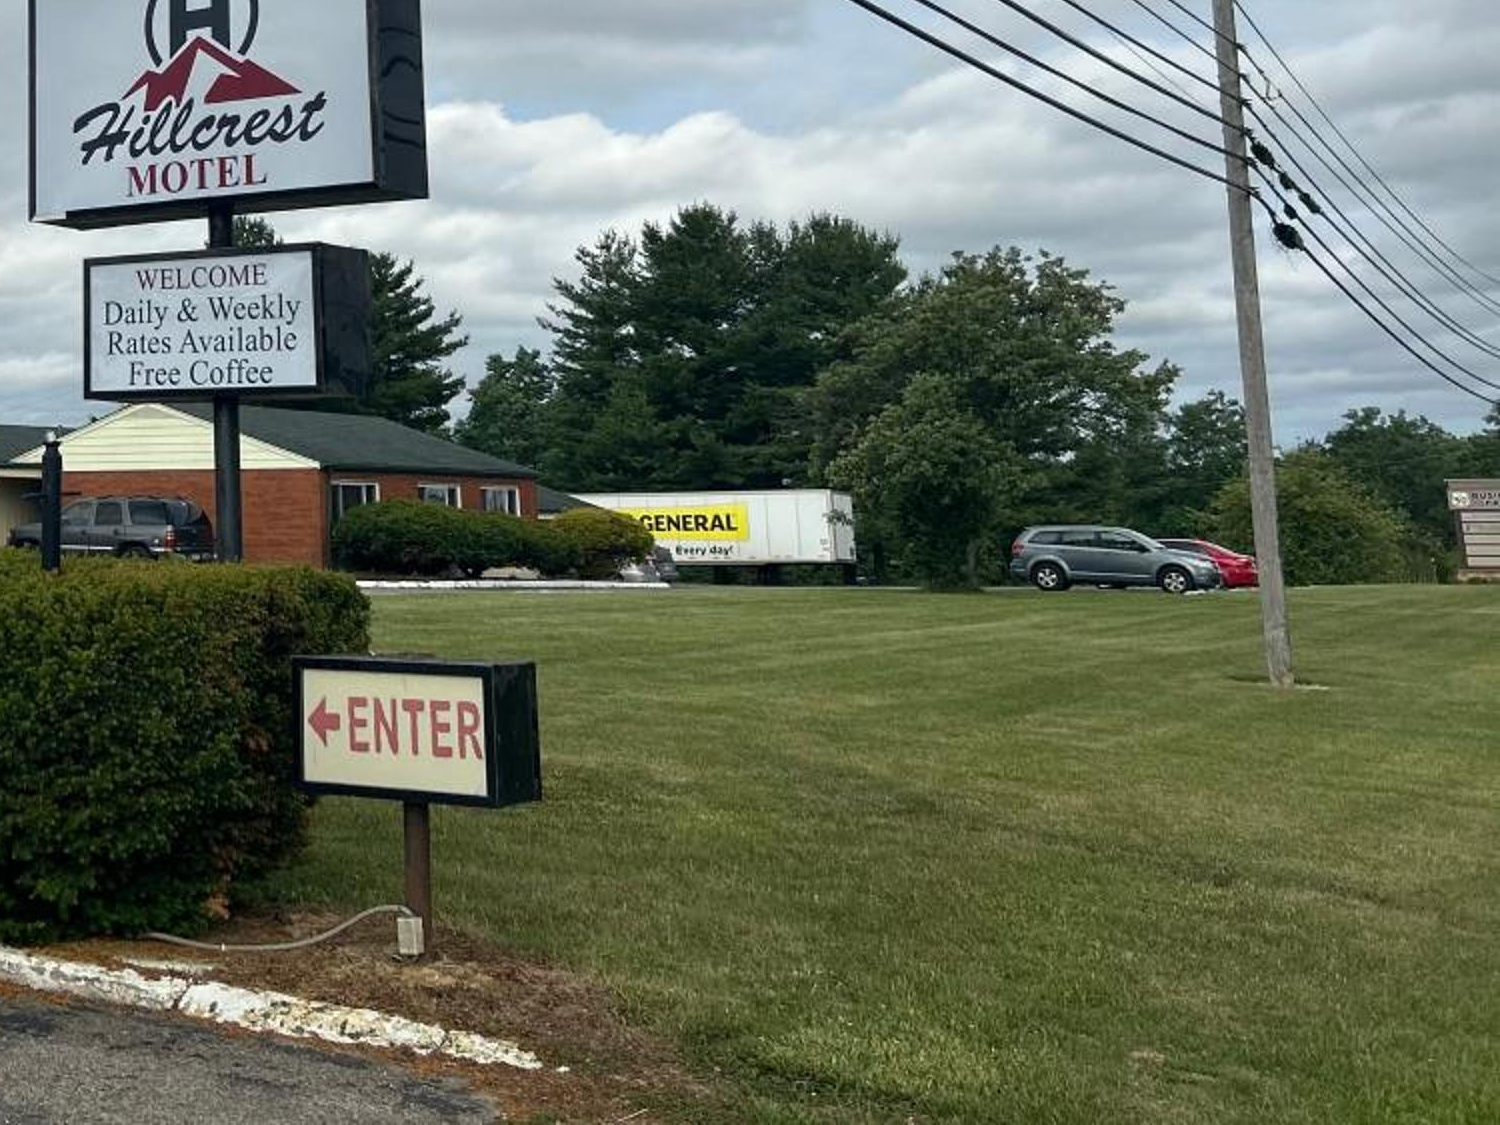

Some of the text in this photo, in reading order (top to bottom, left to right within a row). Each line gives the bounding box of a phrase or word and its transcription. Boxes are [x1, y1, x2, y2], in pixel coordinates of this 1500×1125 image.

[72, 91, 328, 166] Hillcrest
[126, 153, 267, 197] MOTEL
[135, 263, 268, 291] WELCOME
[103, 293, 301, 330] Daily & Weekly
[107, 326, 298, 355] Rates Available
[128, 359, 274, 386] Free Coffee
[640, 513, 739, 532] GENERAL
[675, 544, 734, 556] Every day!
[347, 696, 484, 760] ENTER
